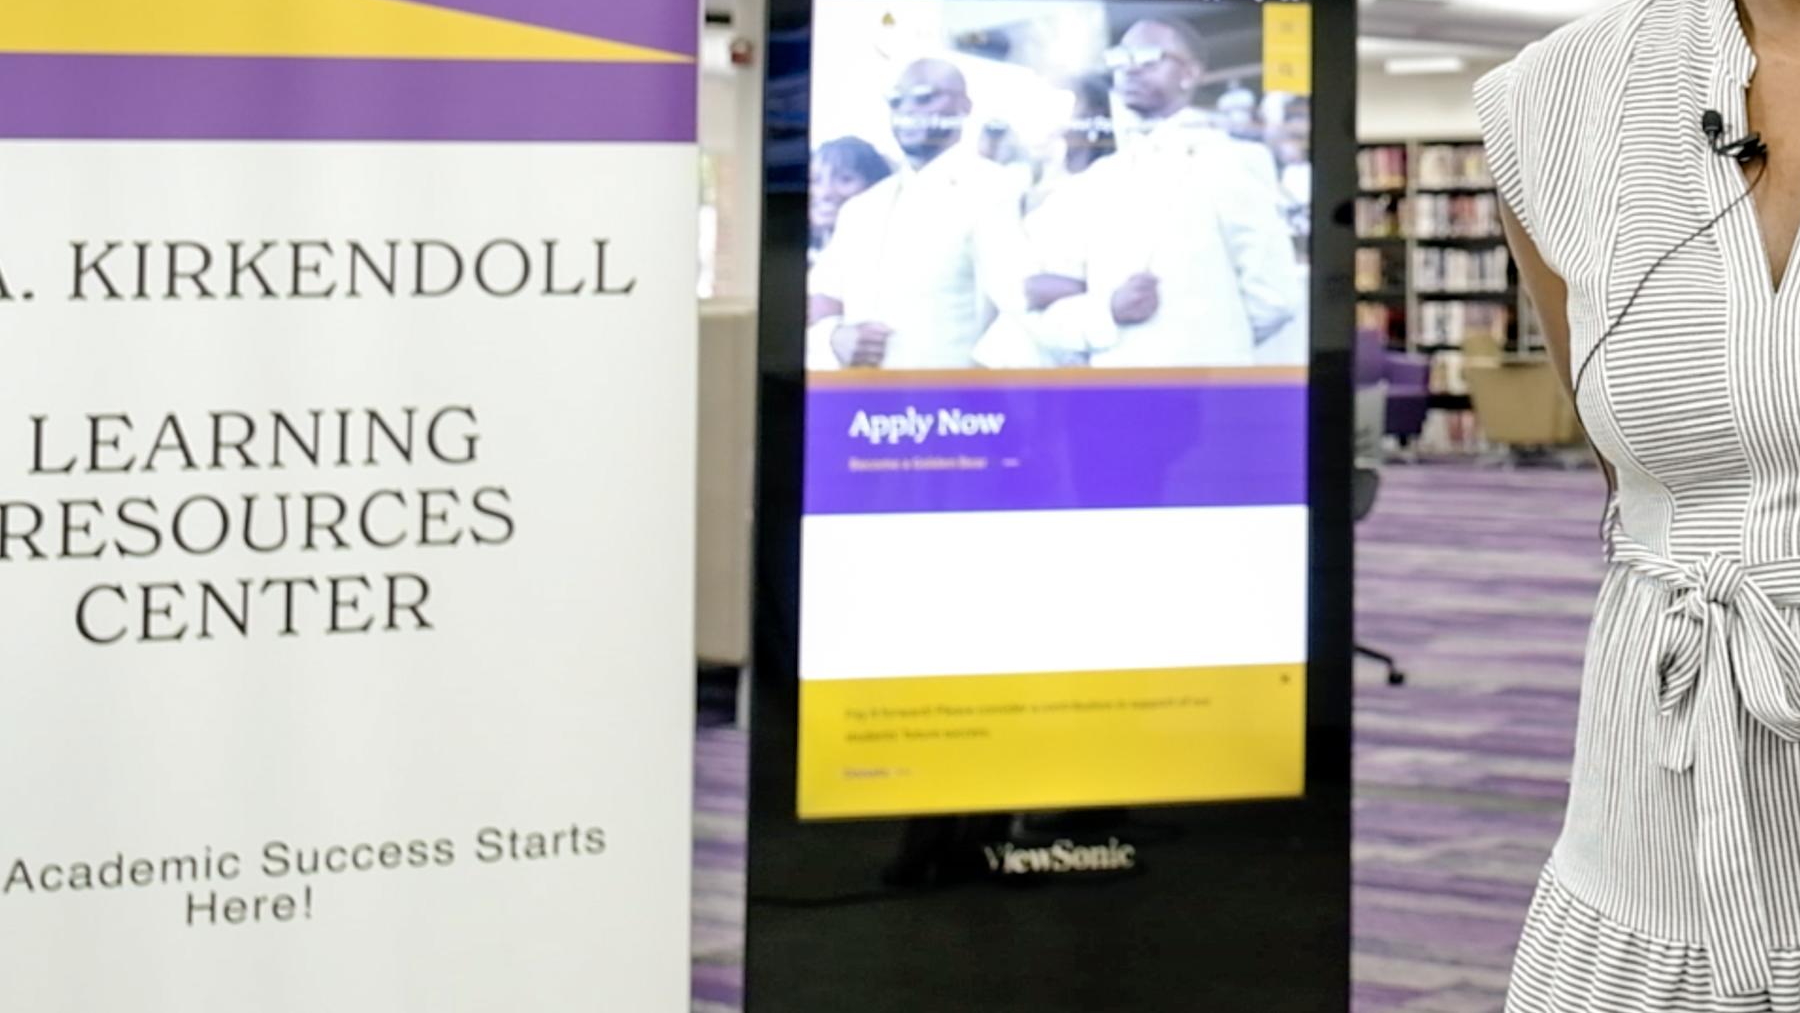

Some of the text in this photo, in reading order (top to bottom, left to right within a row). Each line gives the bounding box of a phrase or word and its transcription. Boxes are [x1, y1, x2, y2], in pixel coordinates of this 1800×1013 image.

[68, 238, 638, 301] KIRKENDOLL
[27, 405, 482, 476] LEARNING
[848, 405, 1006, 445] Apply Now
[0, 486, 516, 562] RESOURCES
[74, 572, 435, 647] CENTER
[3, 825, 607, 894] Academic Success Starts
[983, 836, 1136, 874] ViewSonic
[186, 885, 314, 927] Here!
